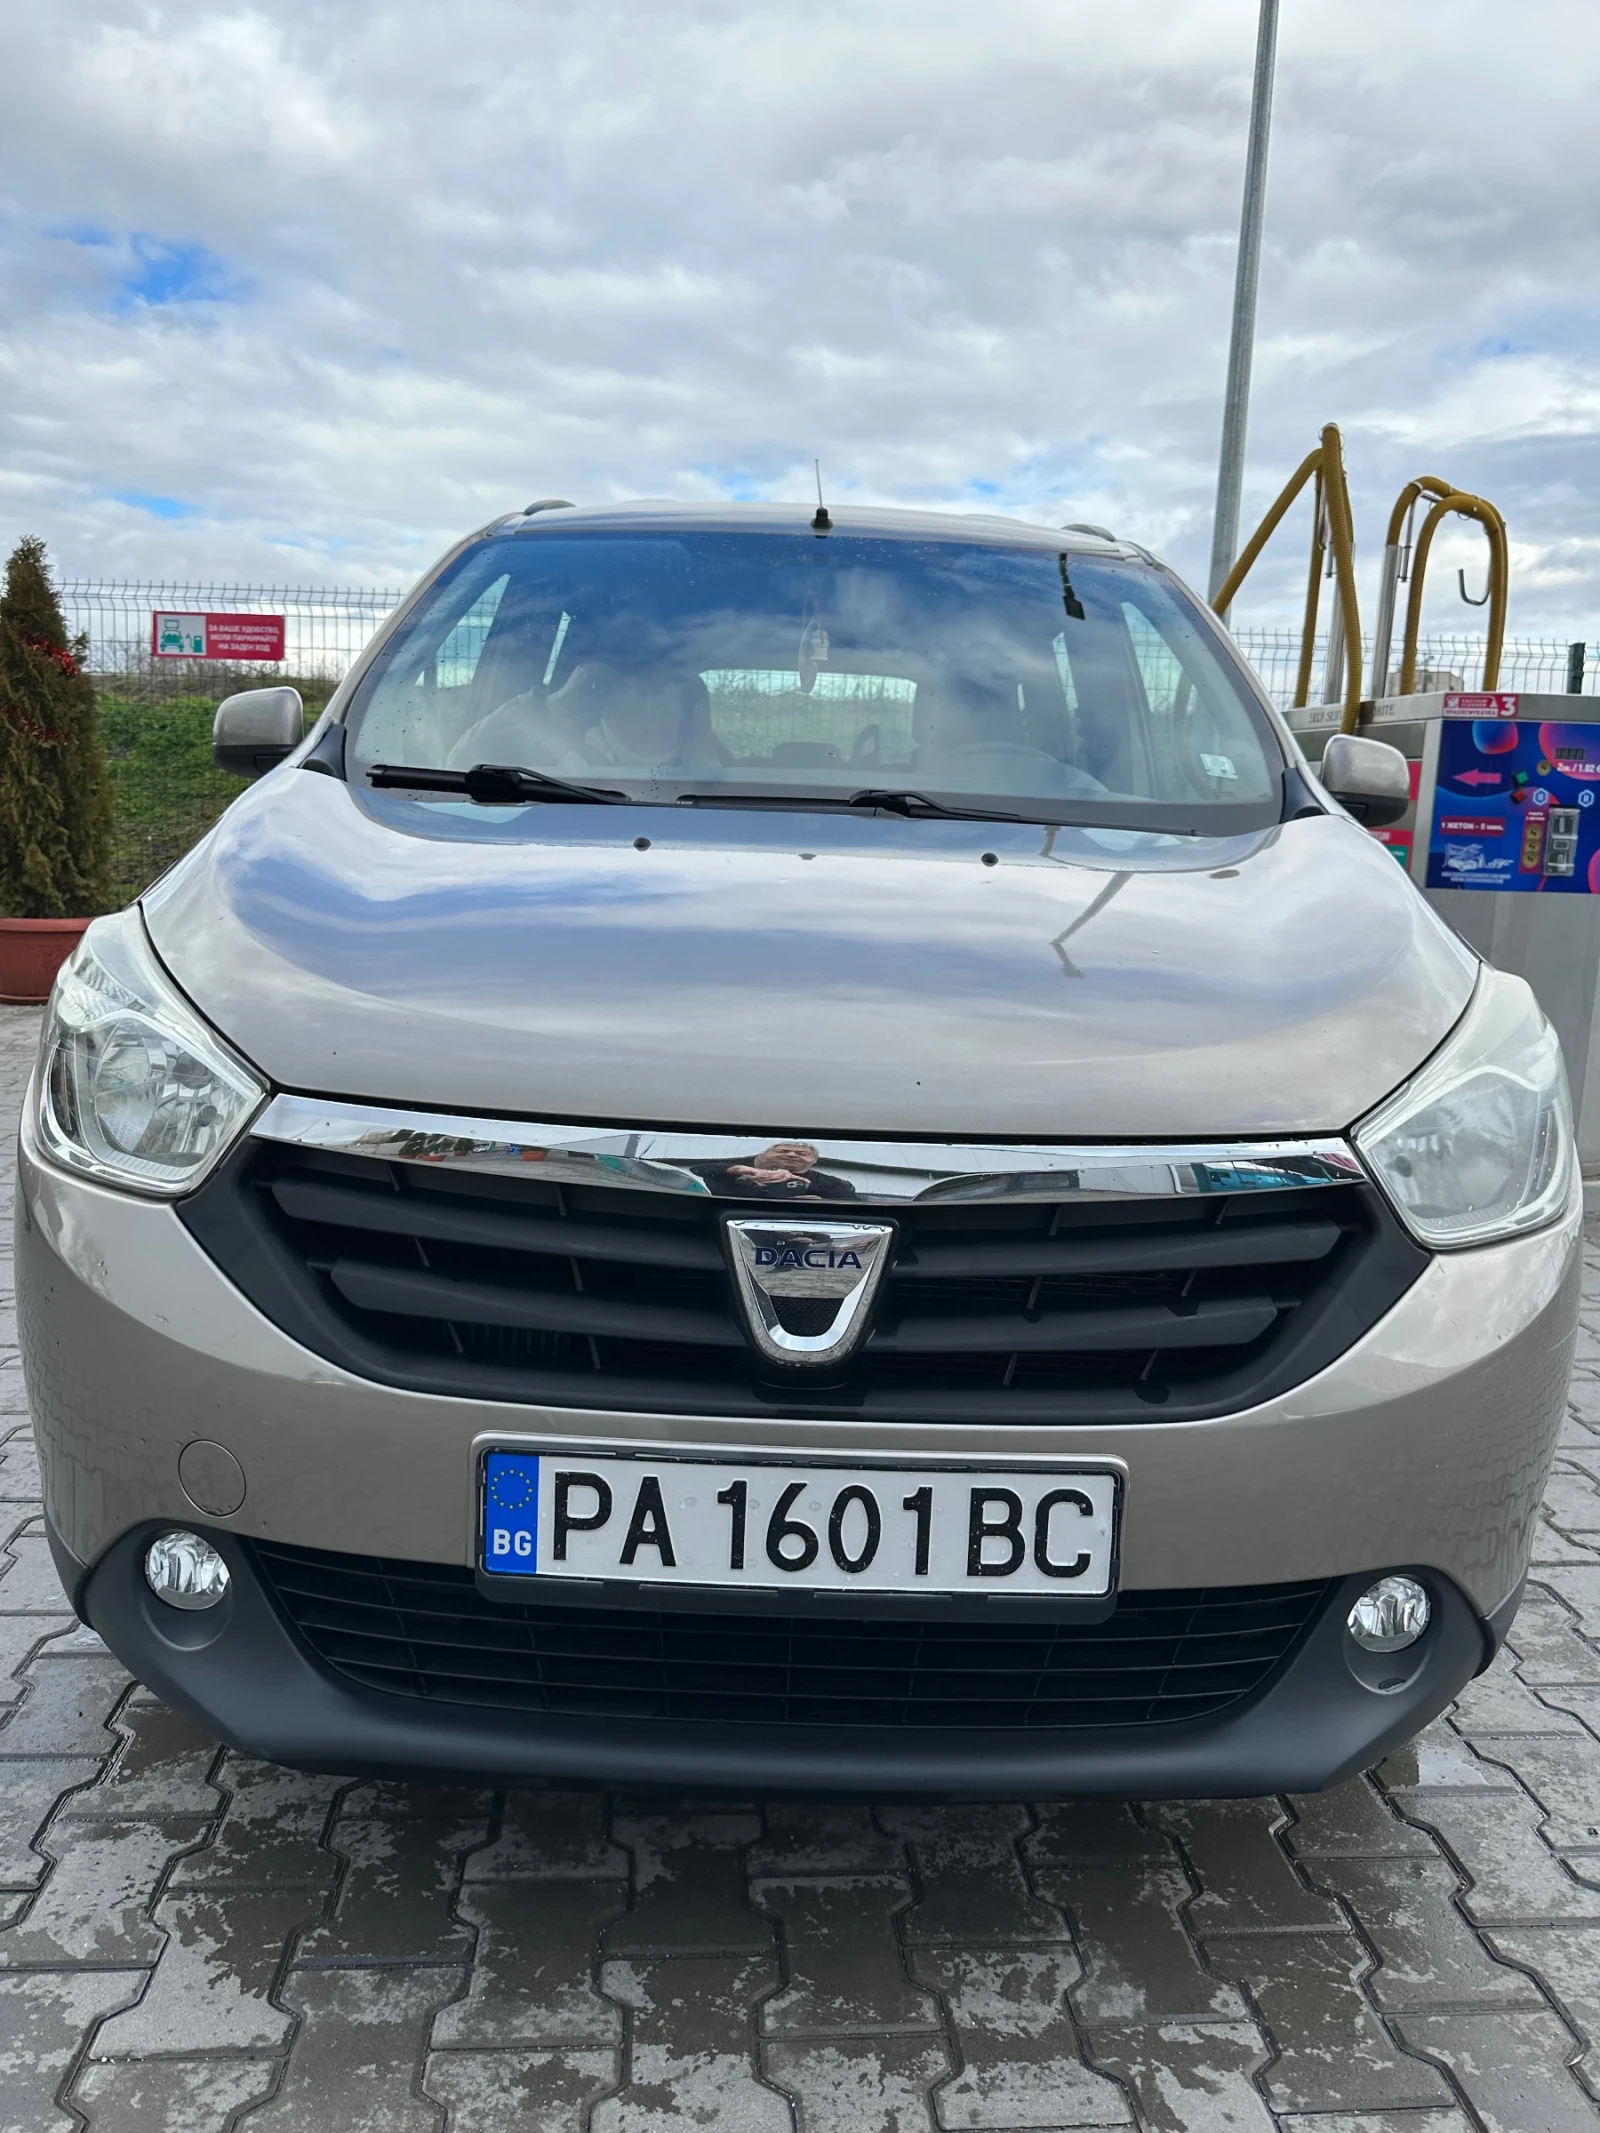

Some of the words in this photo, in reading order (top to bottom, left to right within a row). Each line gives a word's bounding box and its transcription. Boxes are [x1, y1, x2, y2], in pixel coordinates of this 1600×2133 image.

[1500, 696, 1516, 717] 3
[1446, 821, 1475, 830] ЖЕТОН
[755, 1247, 863, 1269] DACIA
[553, 1470, 677, 1567] PA
[716, 1479, 932, 1577] 1601
[966, 1486, 1094, 1579] BC
[493, 1528, 532, 1557] BG
